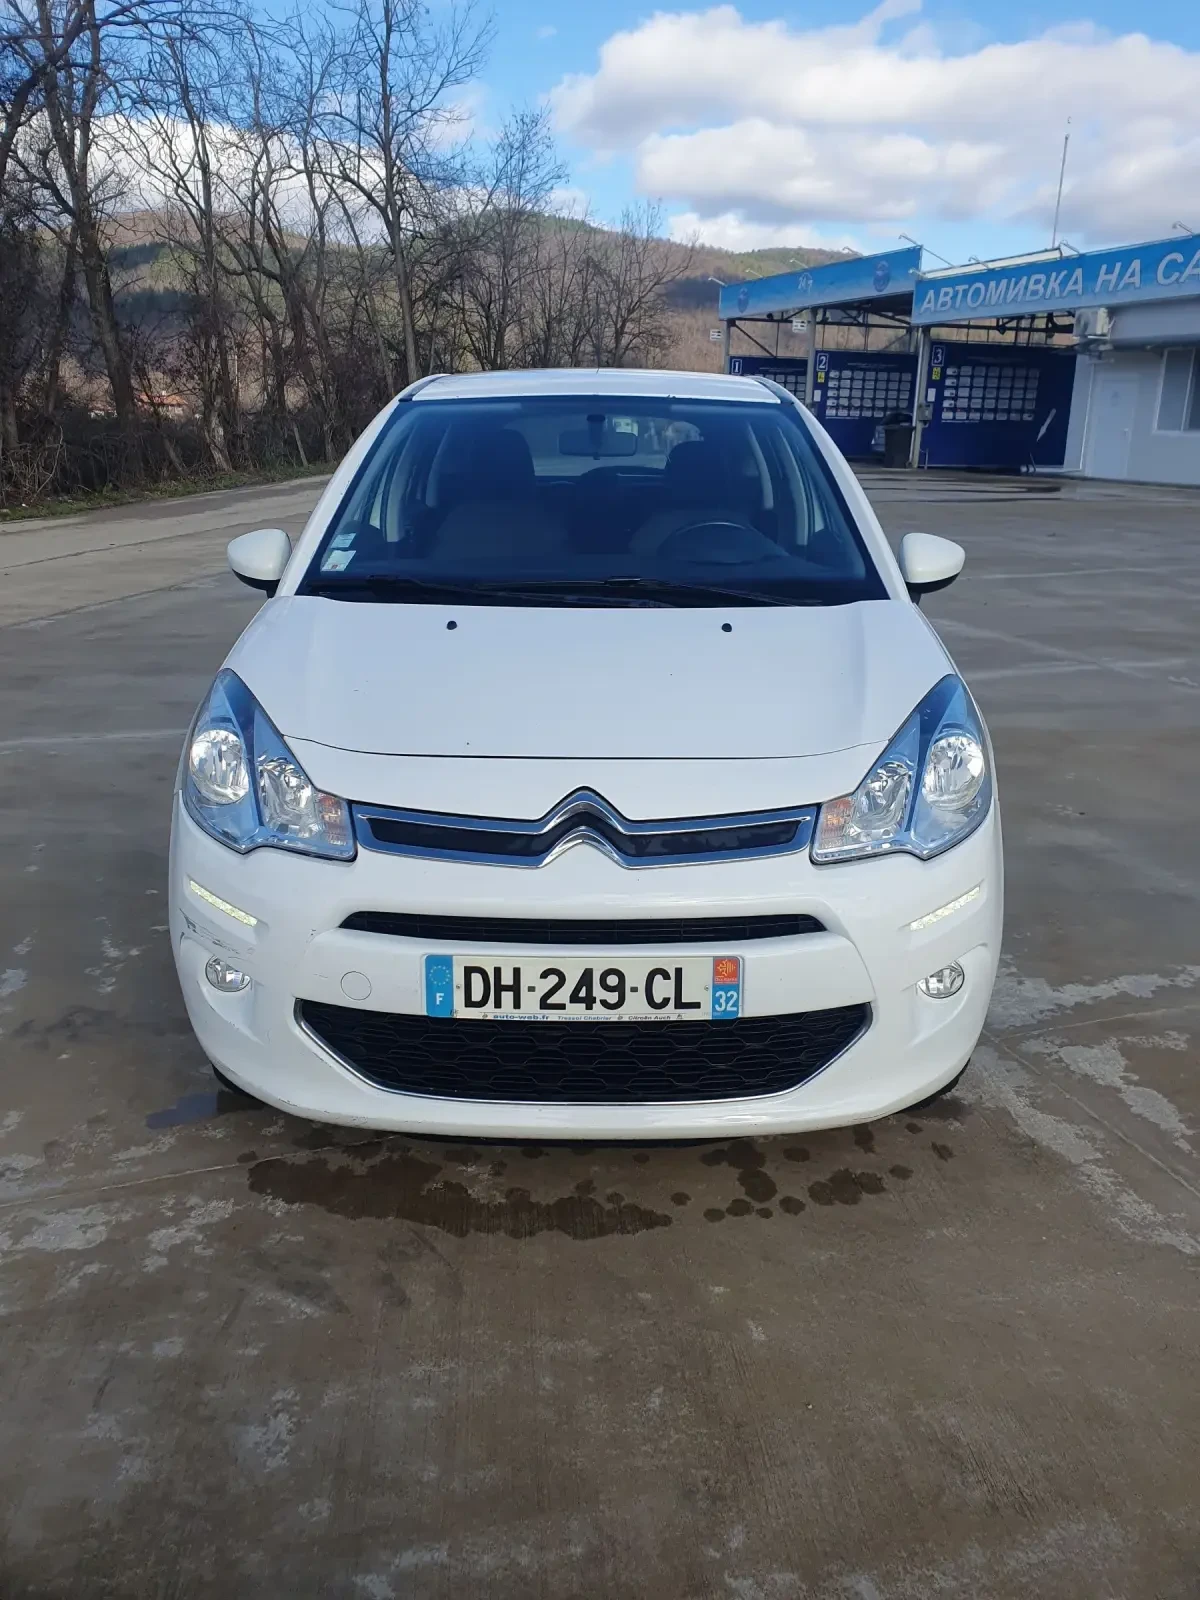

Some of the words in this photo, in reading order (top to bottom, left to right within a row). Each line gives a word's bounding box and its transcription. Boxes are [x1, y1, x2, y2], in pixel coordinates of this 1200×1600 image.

[920, 267, 1083, 314] АВТОМИВКА
[1094, 258, 1141, 293] НА
[435, 993, 444, 1005] F
[463, 965, 702, 1011] DH-249-CL
[714, 990, 738, 1011] 32
